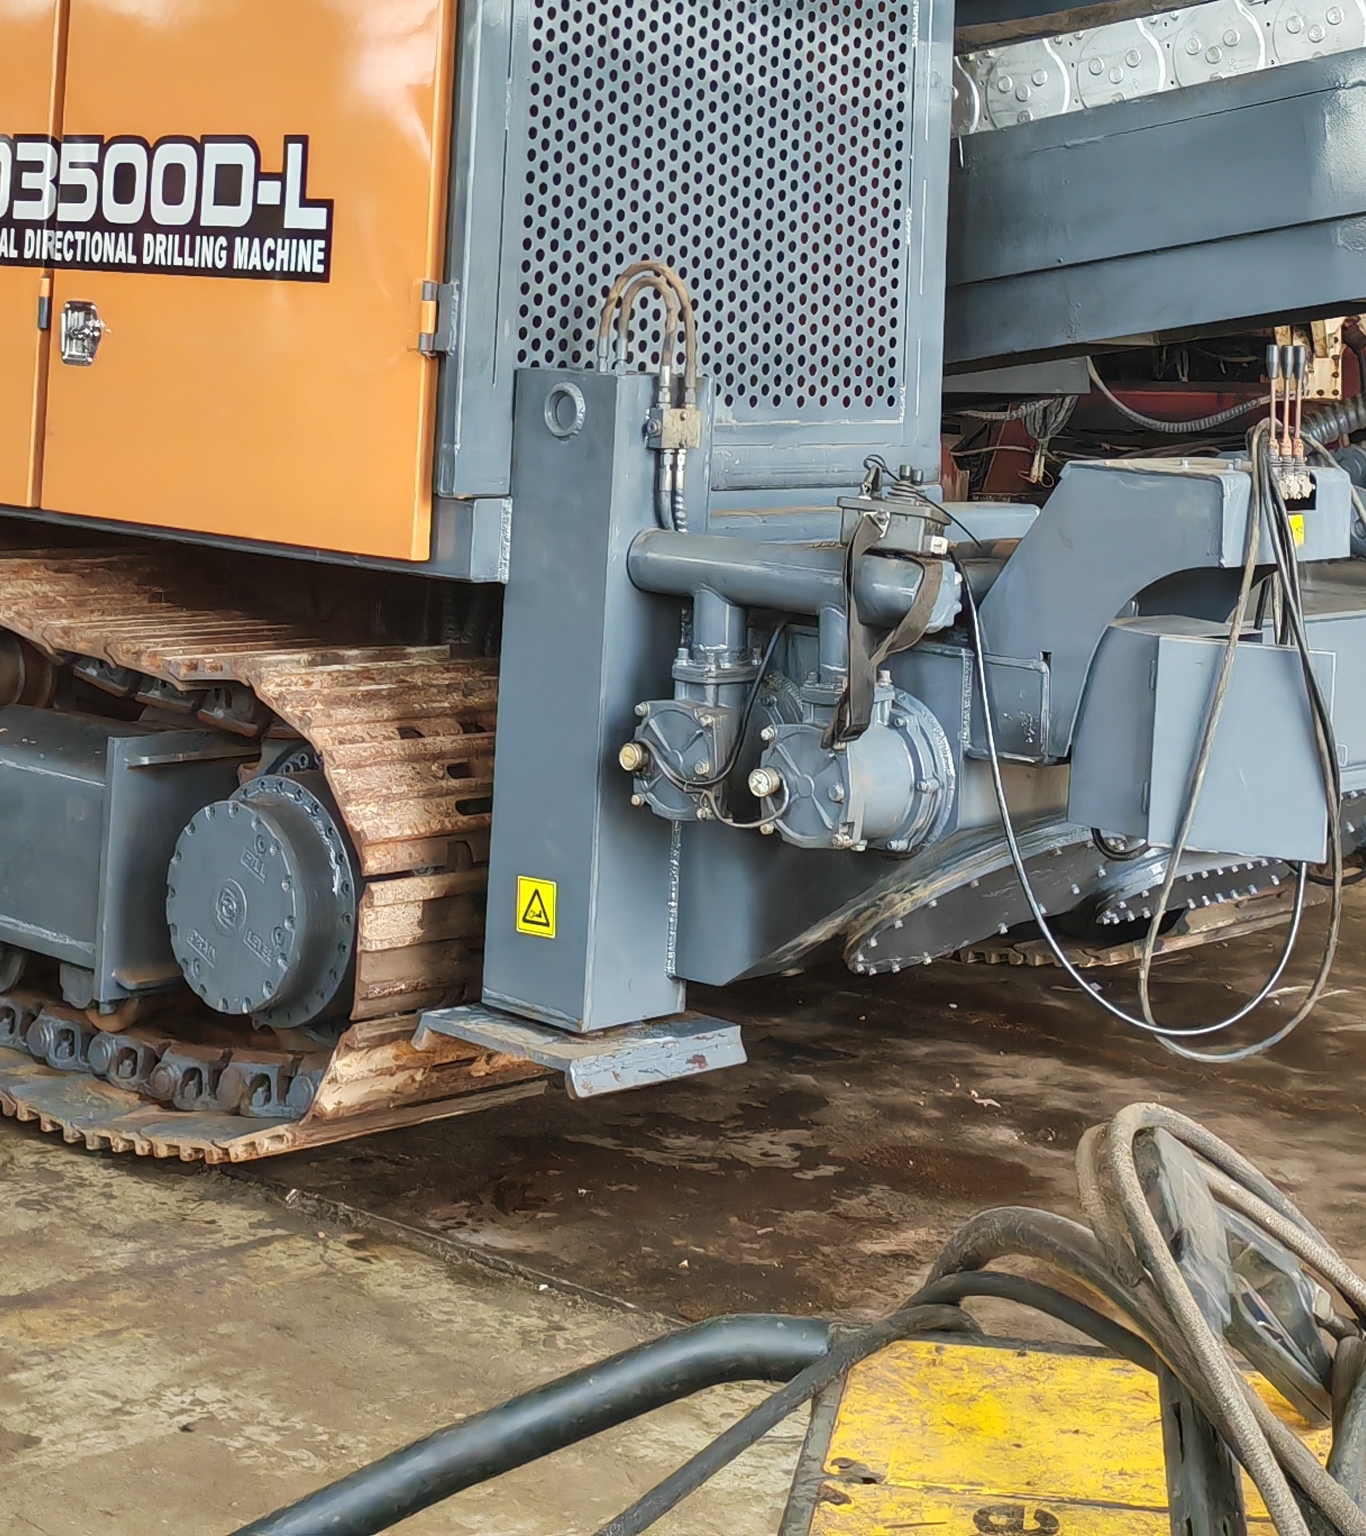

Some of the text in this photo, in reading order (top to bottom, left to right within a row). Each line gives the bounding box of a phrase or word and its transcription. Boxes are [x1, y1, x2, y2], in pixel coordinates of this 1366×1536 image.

[23, 228, 137, 265] DIRECTIONAL
[142, 233, 227, 269] DRILLING
[233, 237, 326, 274] MACHINE
